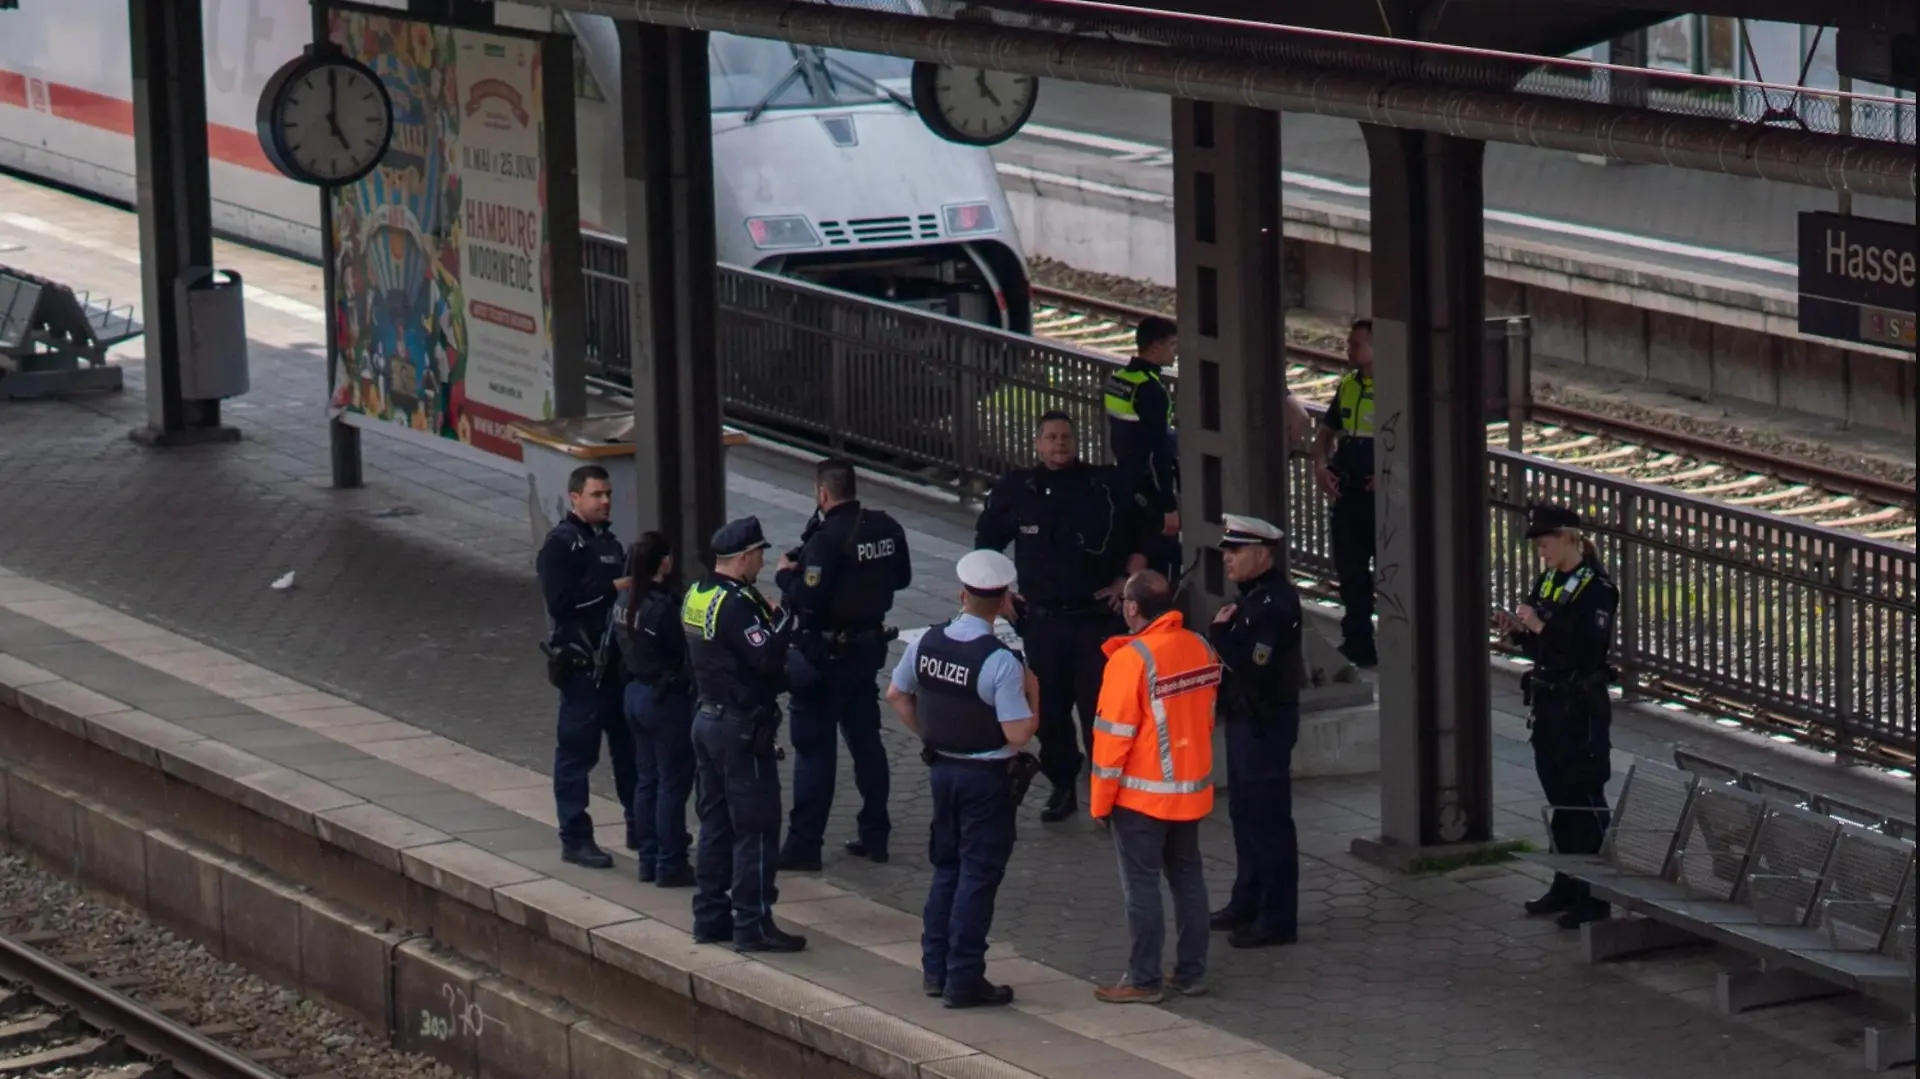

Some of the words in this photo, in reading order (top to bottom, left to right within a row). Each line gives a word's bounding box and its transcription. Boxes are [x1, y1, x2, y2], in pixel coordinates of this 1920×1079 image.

[466, 198, 536, 257] HAMBURG
[468, 244, 534, 293] MOORWEIDE
[1826, 229, 1916, 287] Hasse
[857, 538, 895, 562] POLIZEI
[919, 655, 969, 686] POLIZEI
